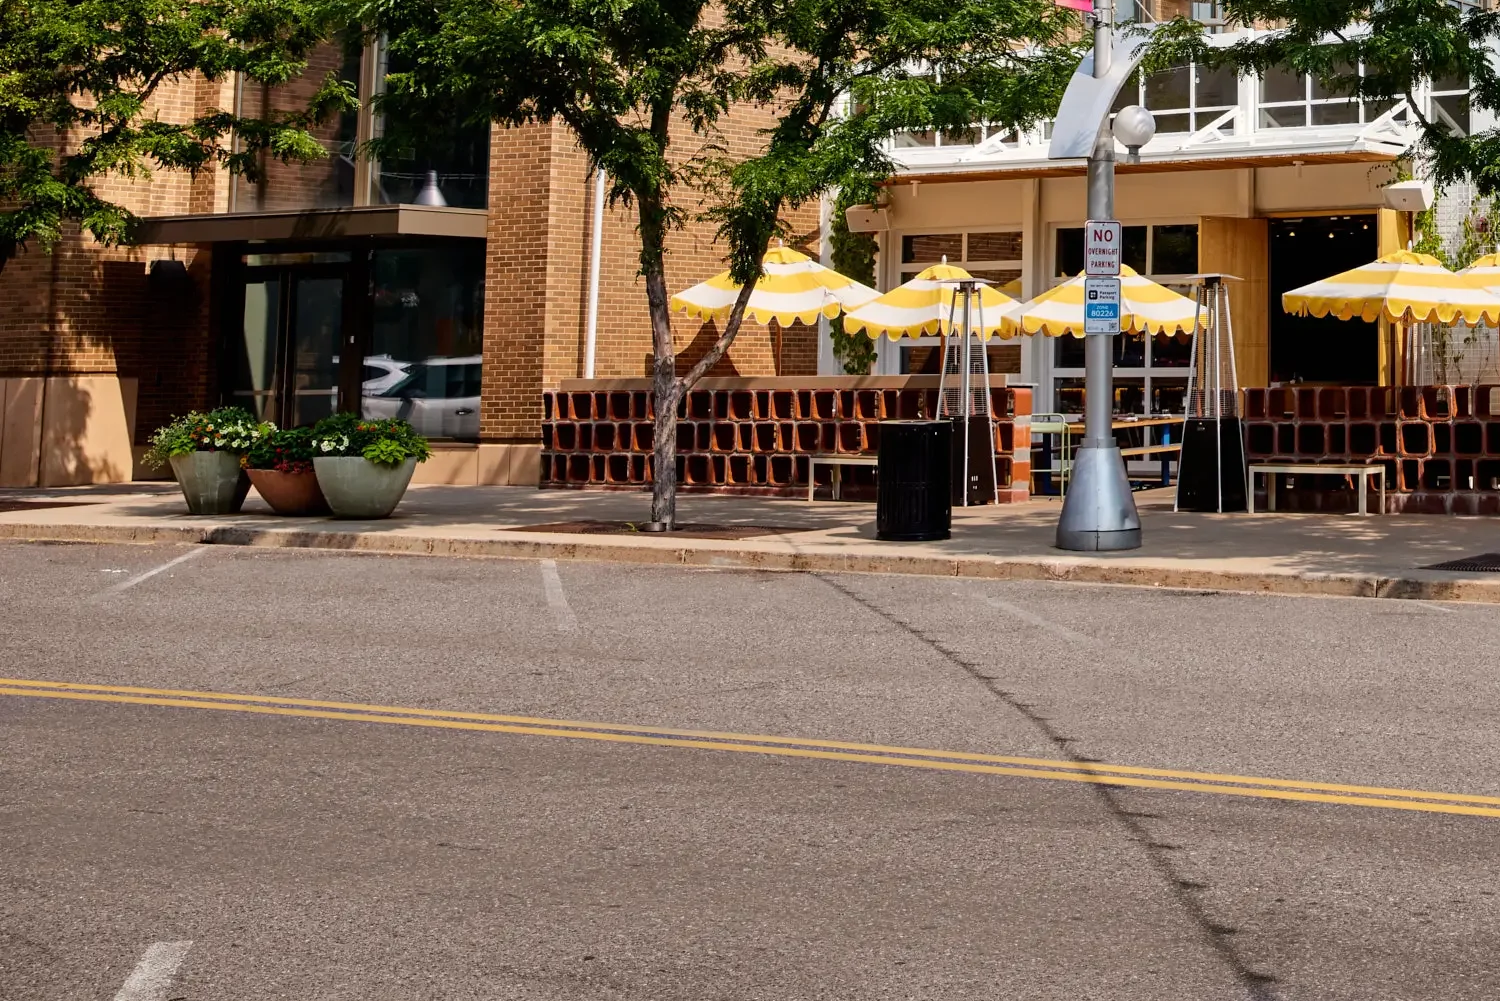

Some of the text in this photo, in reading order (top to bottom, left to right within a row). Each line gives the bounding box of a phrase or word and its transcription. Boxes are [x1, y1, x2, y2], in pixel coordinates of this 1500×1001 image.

[1094, 229, 1113, 242] NO
[1088, 248, 1118, 256] OVERNIGHT
[1091, 261, 1115, 269] PARKING
